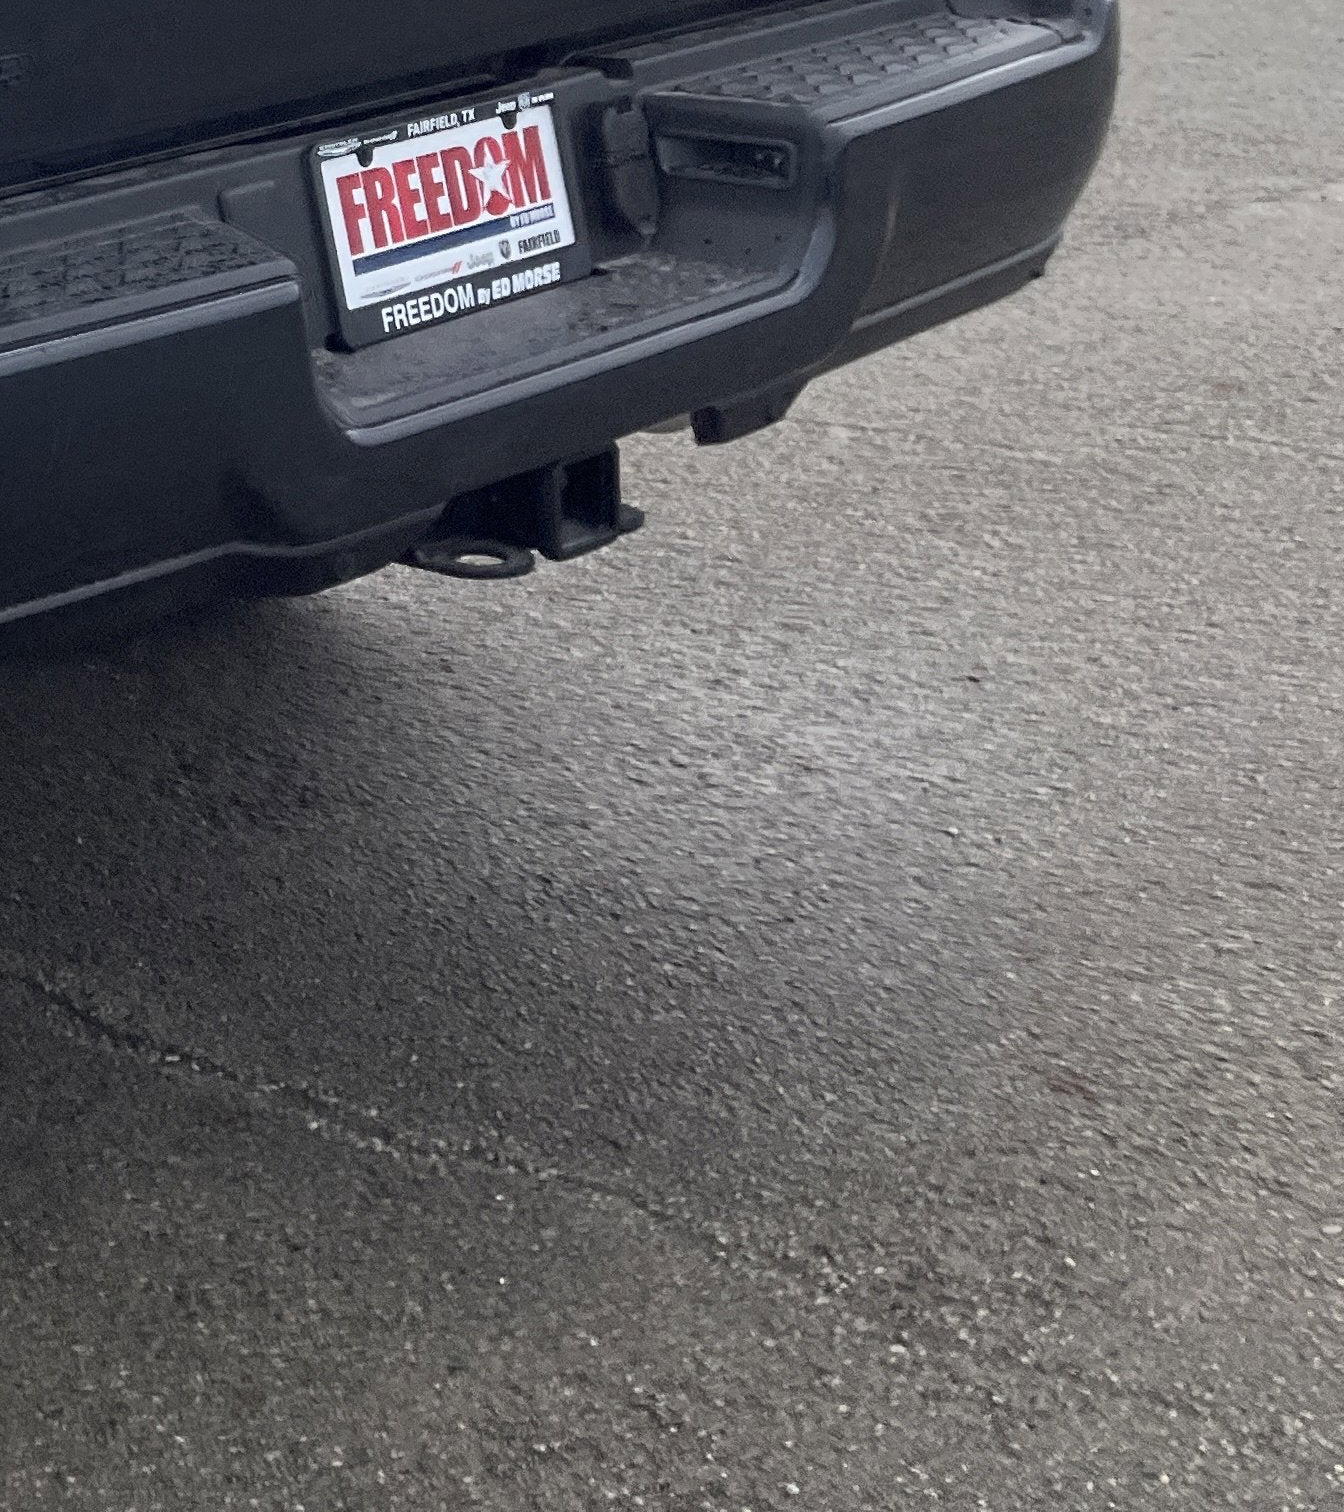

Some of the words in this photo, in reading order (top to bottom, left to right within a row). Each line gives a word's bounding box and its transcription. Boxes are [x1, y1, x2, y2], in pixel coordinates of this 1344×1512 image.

[461, 108, 476, 124] TX
[336, 125, 551, 256] FREEDOM
[518, 230, 561, 255] FAIRFIELD
[381, 284, 474, 333] FREEDOM
[491, 277, 511, 300] ED
[512, 262, 561, 294] MORSE
